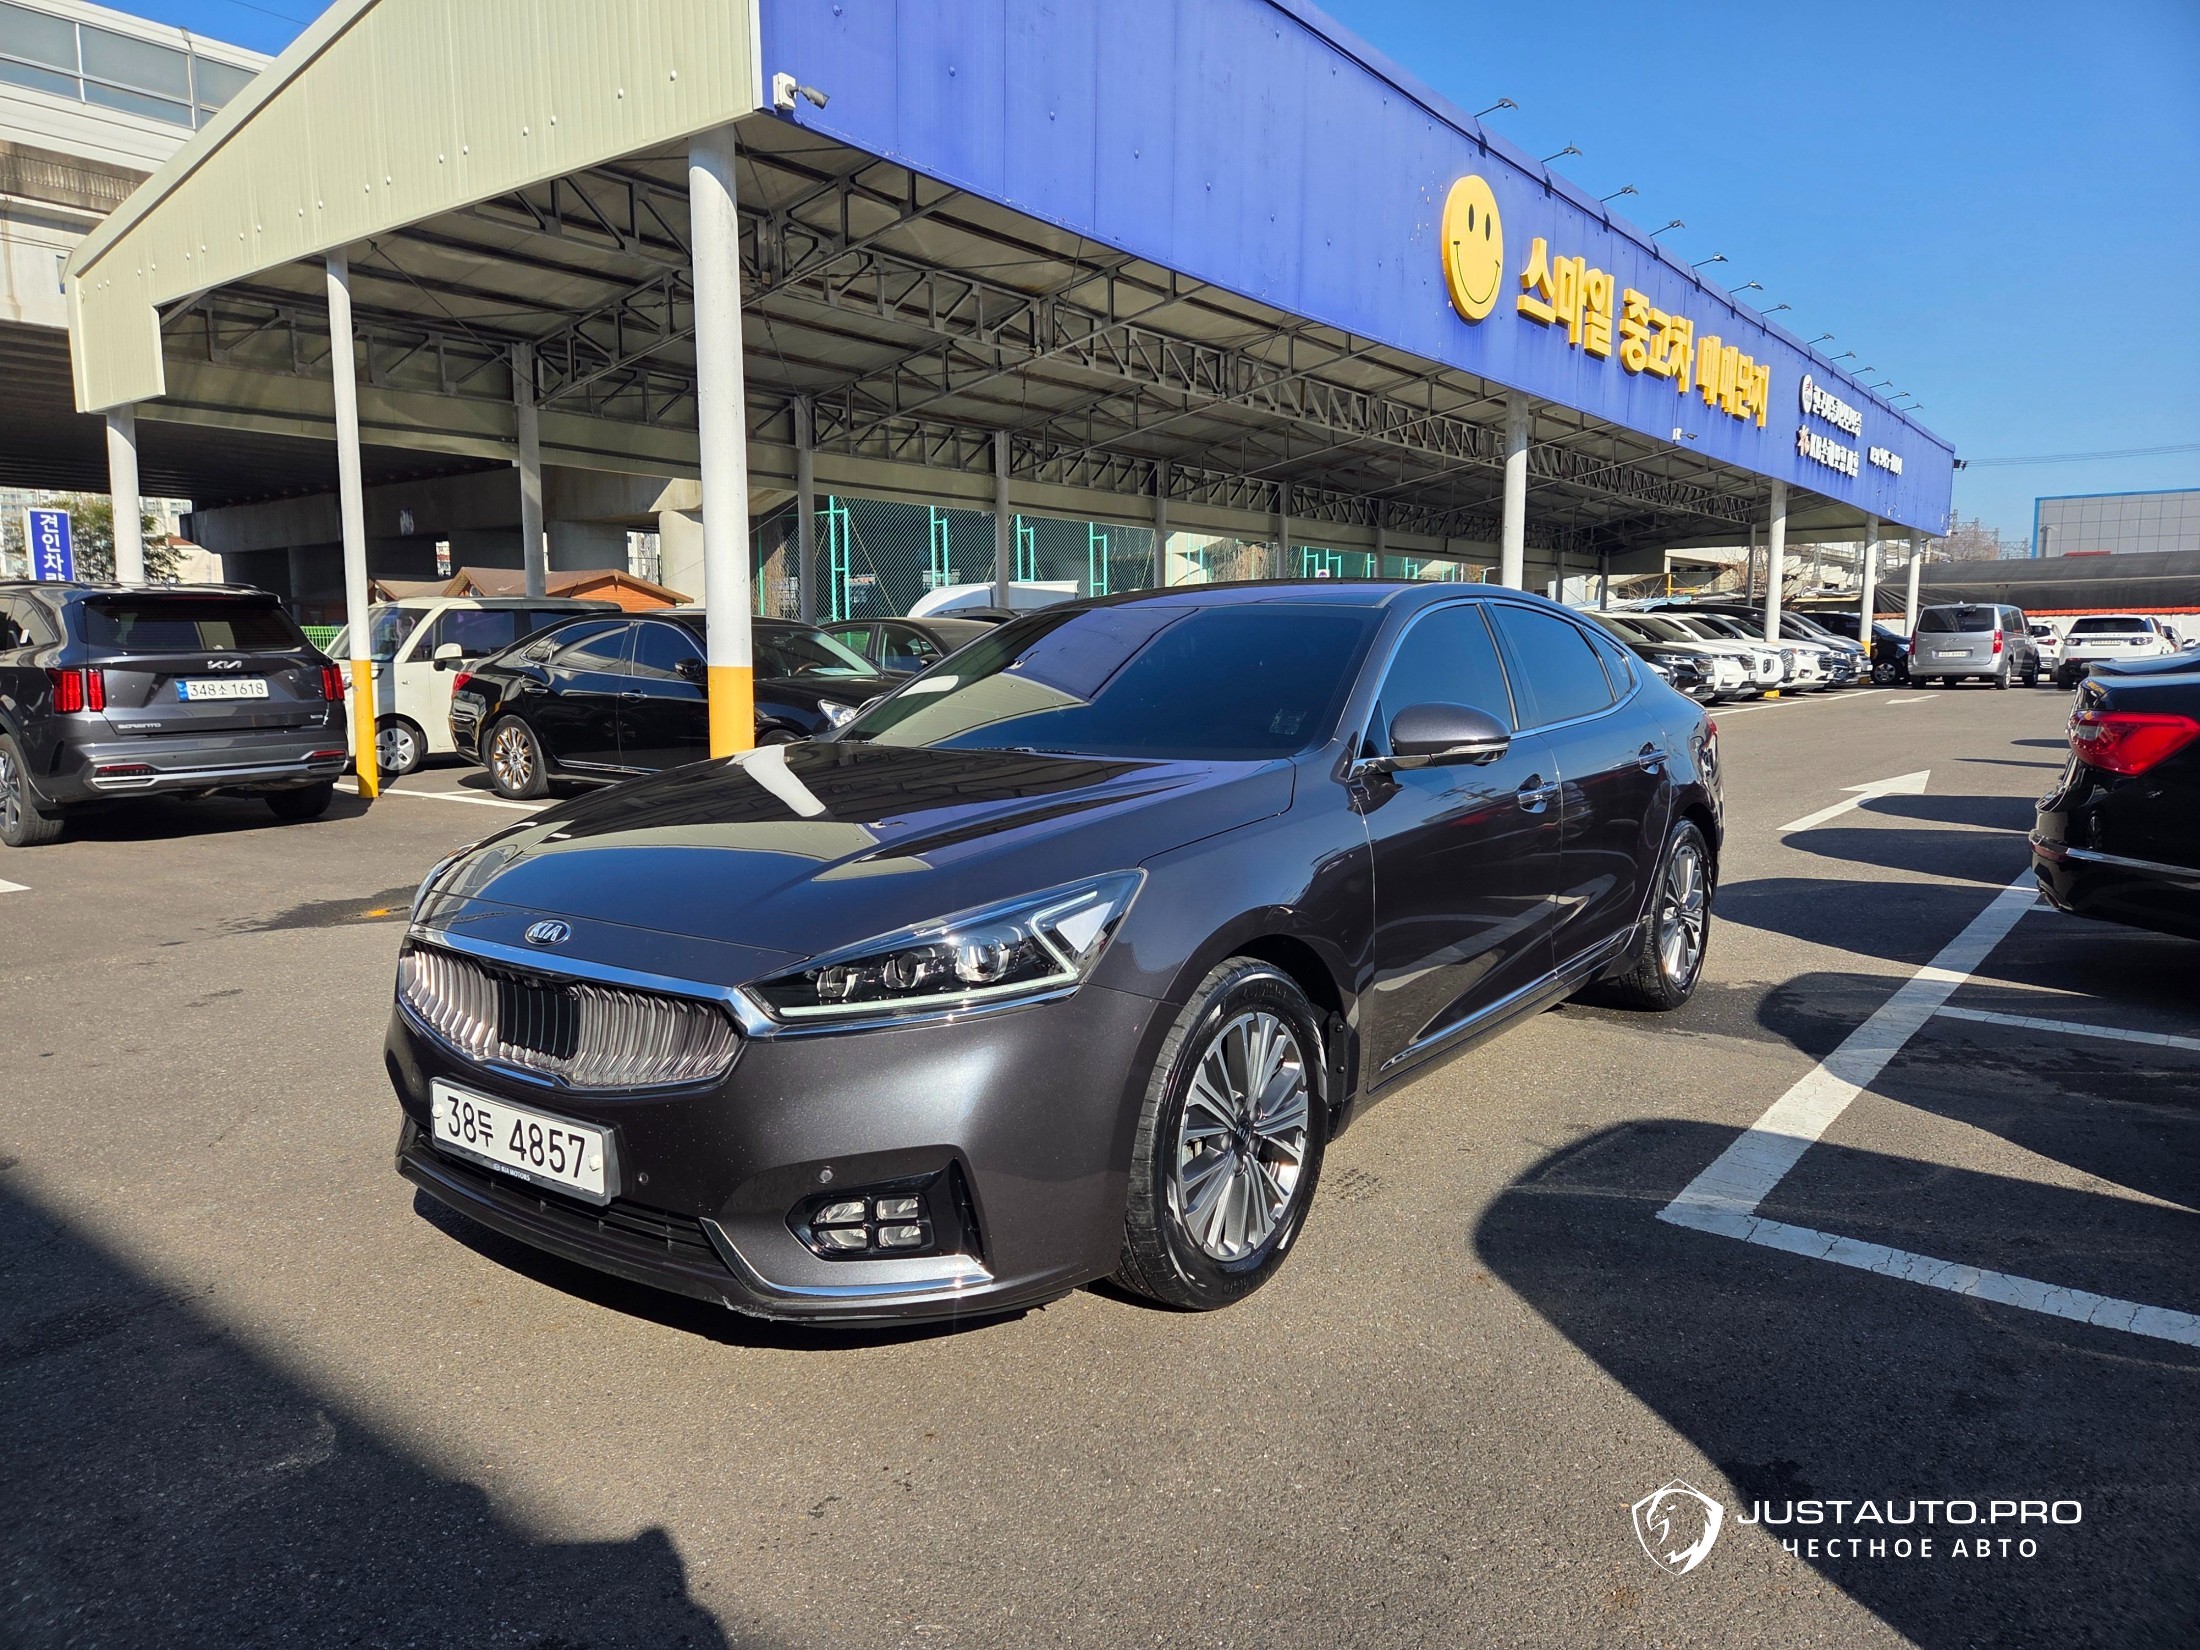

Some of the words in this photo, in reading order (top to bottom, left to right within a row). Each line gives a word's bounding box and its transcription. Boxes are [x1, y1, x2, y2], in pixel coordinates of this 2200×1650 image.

[1517, 237, 1614, 357] 스마일
[1619, 288, 1694, 393] 중고차
[1695, 335, 1770, 427] 매매단지
[190, 683, 228, 697] 348소
[231, 682, 264, 695] 1618
[528, 922, 563, 942] KIA
[447, 1095, 494, 1148] 38두
[508, 1118, 585, 1179] 4857
[509, 1168, 531, 1181] MOTORS
